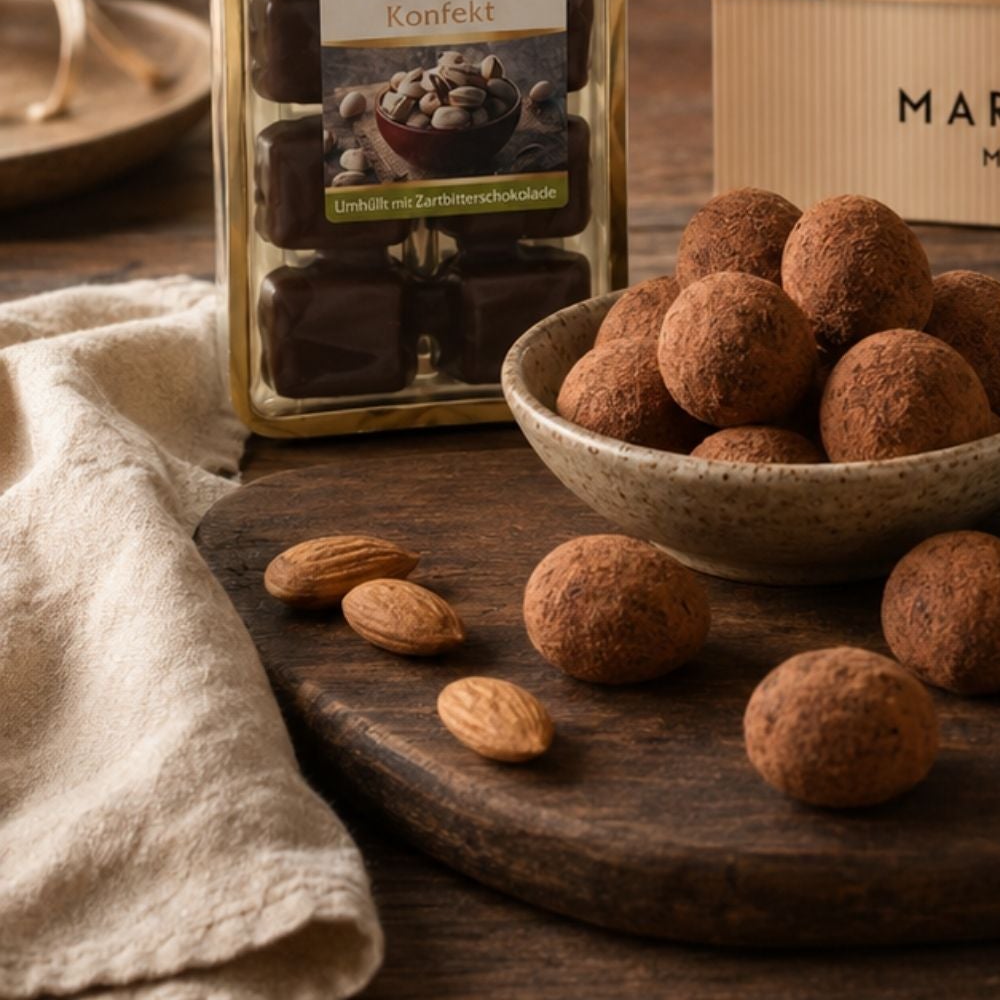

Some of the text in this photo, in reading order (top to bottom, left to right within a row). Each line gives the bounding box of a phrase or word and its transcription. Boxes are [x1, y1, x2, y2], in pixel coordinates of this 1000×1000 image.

[386, 1, 495, 28] Konfekt
[391, 196, 413, 209] mit
[415, 186, 557, 209] Zartbitterschokolade
